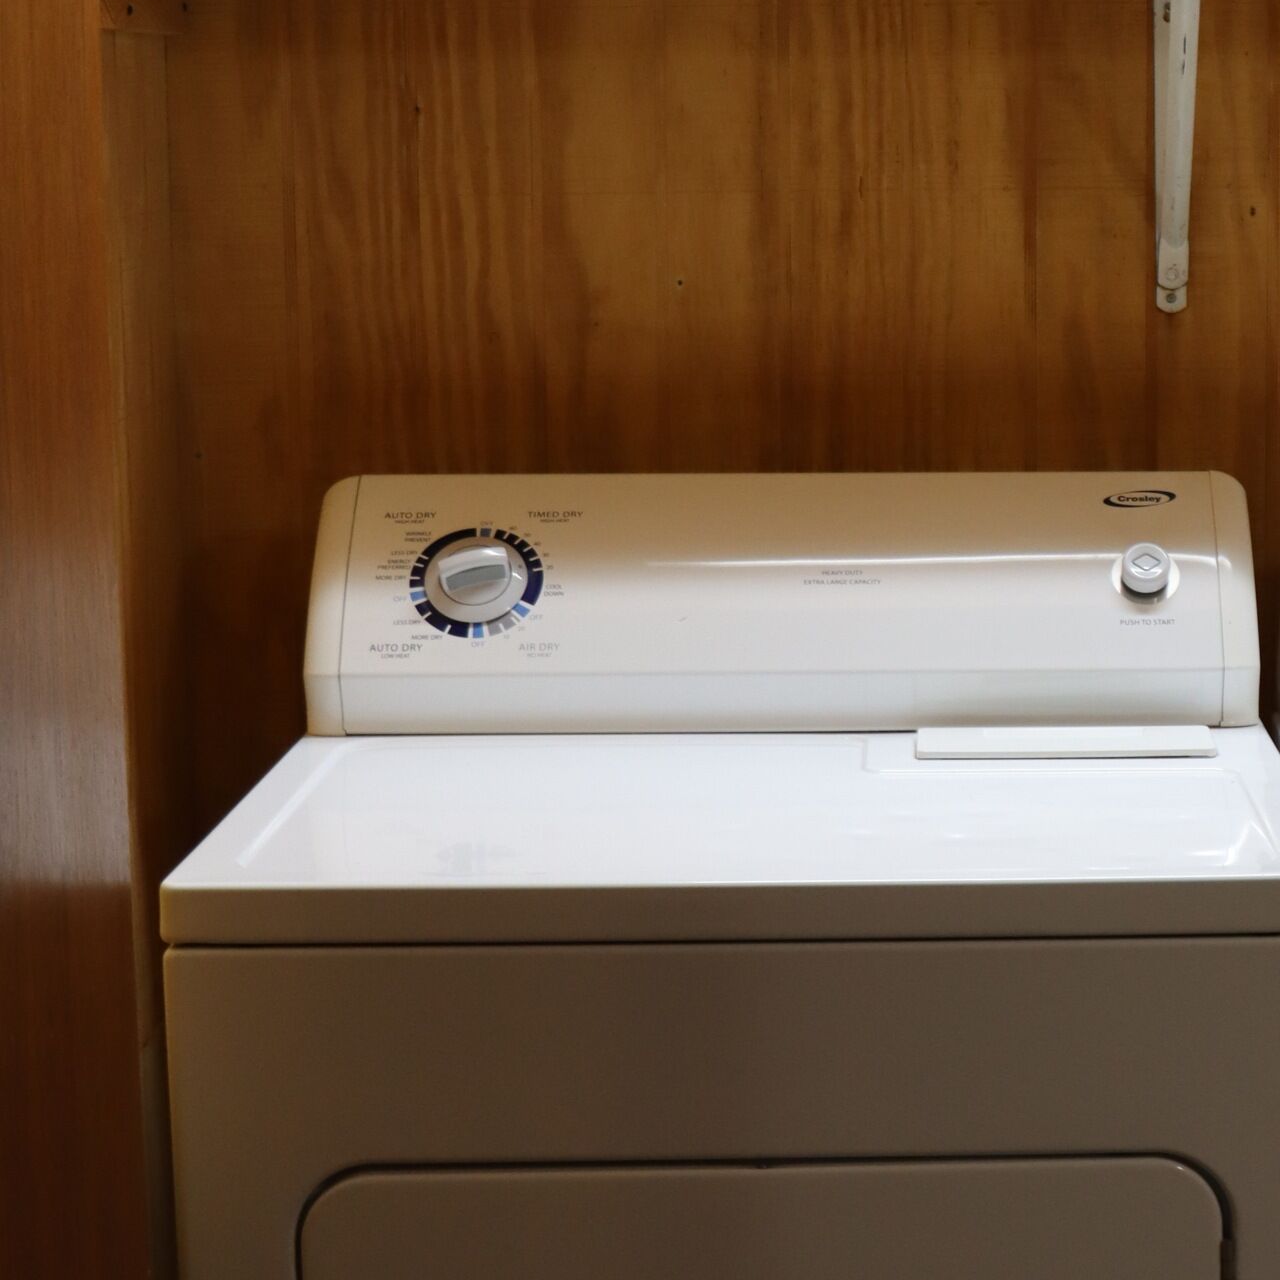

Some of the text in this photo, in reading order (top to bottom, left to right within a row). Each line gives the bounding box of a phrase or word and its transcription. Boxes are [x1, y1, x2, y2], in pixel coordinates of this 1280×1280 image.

[1117, 495, 1162, 504] Crosley
[384, 511, 437, 519] AUTO DRY
[369, 643, 423, 652] AUTO DRY
[519, 642, 560, 652] AIR DRY
